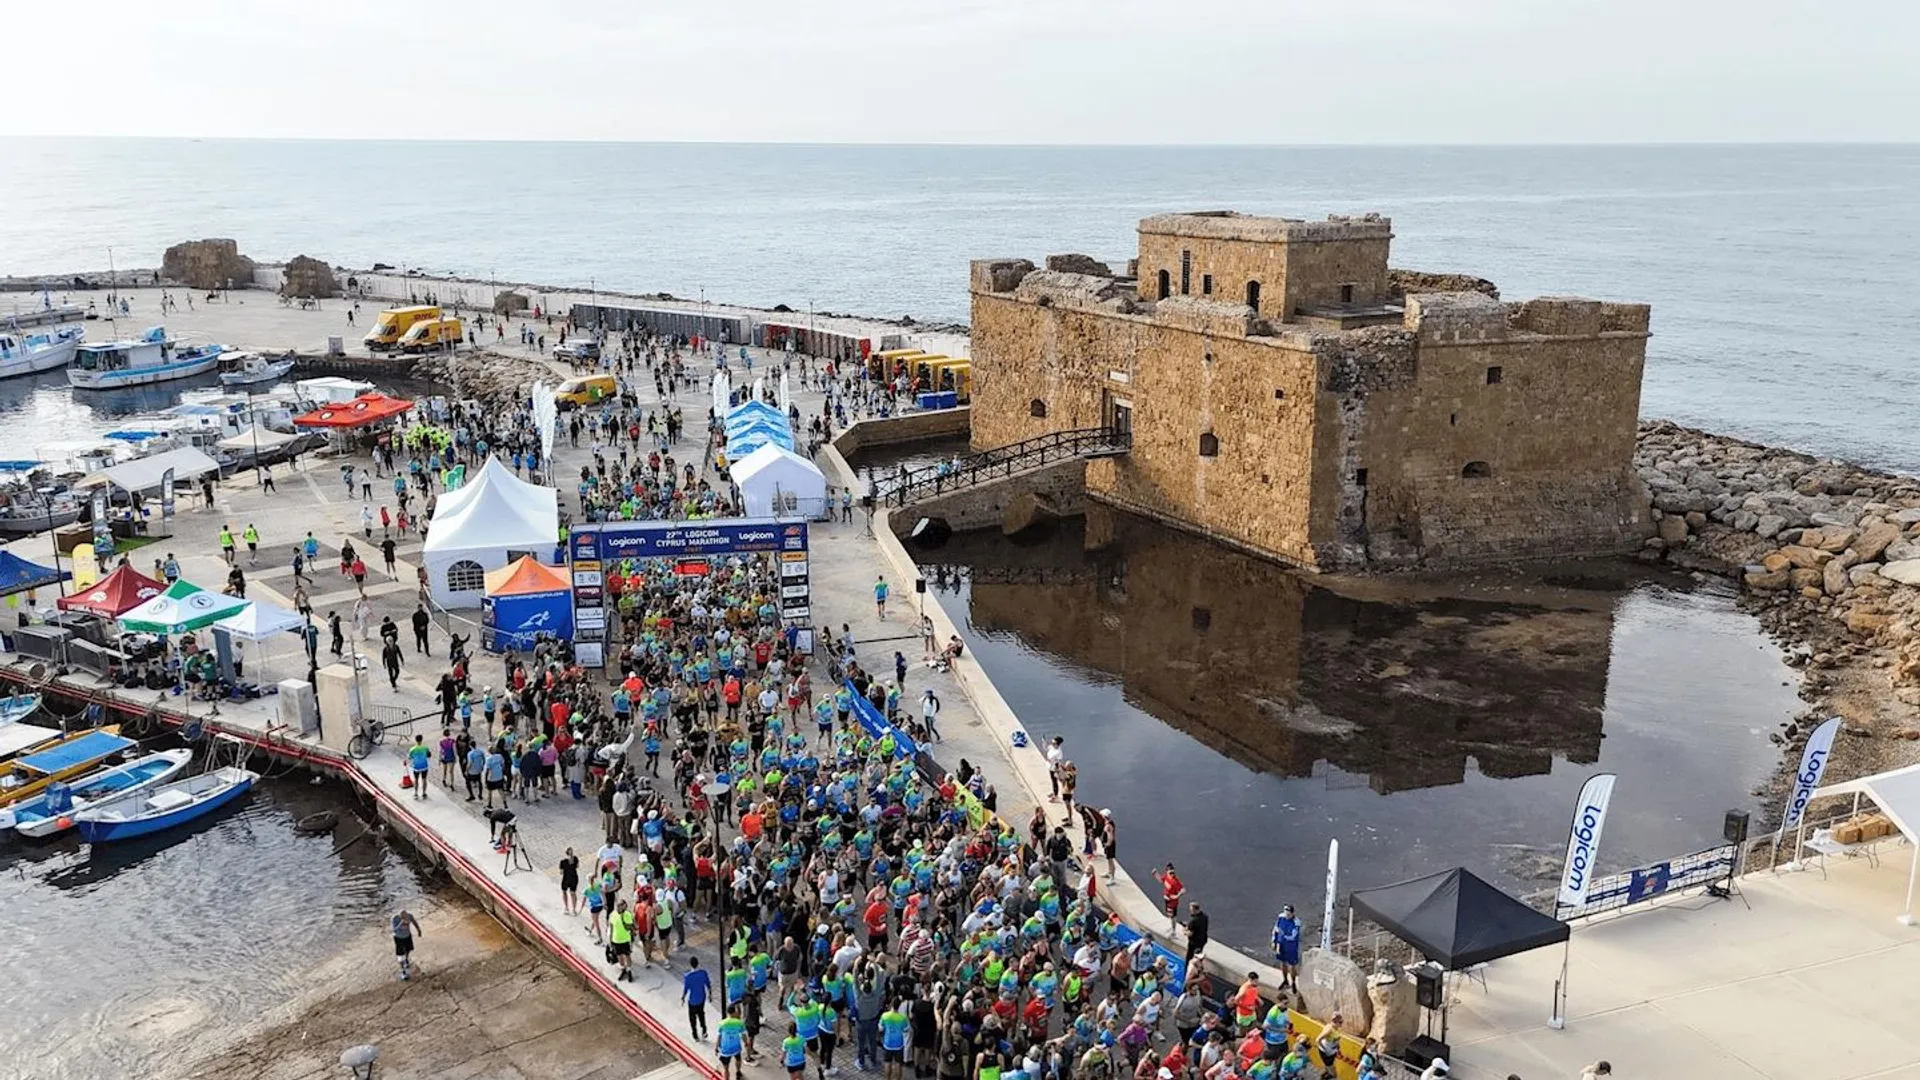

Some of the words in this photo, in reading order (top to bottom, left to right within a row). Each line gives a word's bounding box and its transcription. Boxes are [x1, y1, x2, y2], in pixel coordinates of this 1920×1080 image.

[685, 530, 720, 539] LOGICOM
[656, 539, 686, 548] CYPRUS
[689, 536, 730, 545] MARATHON
